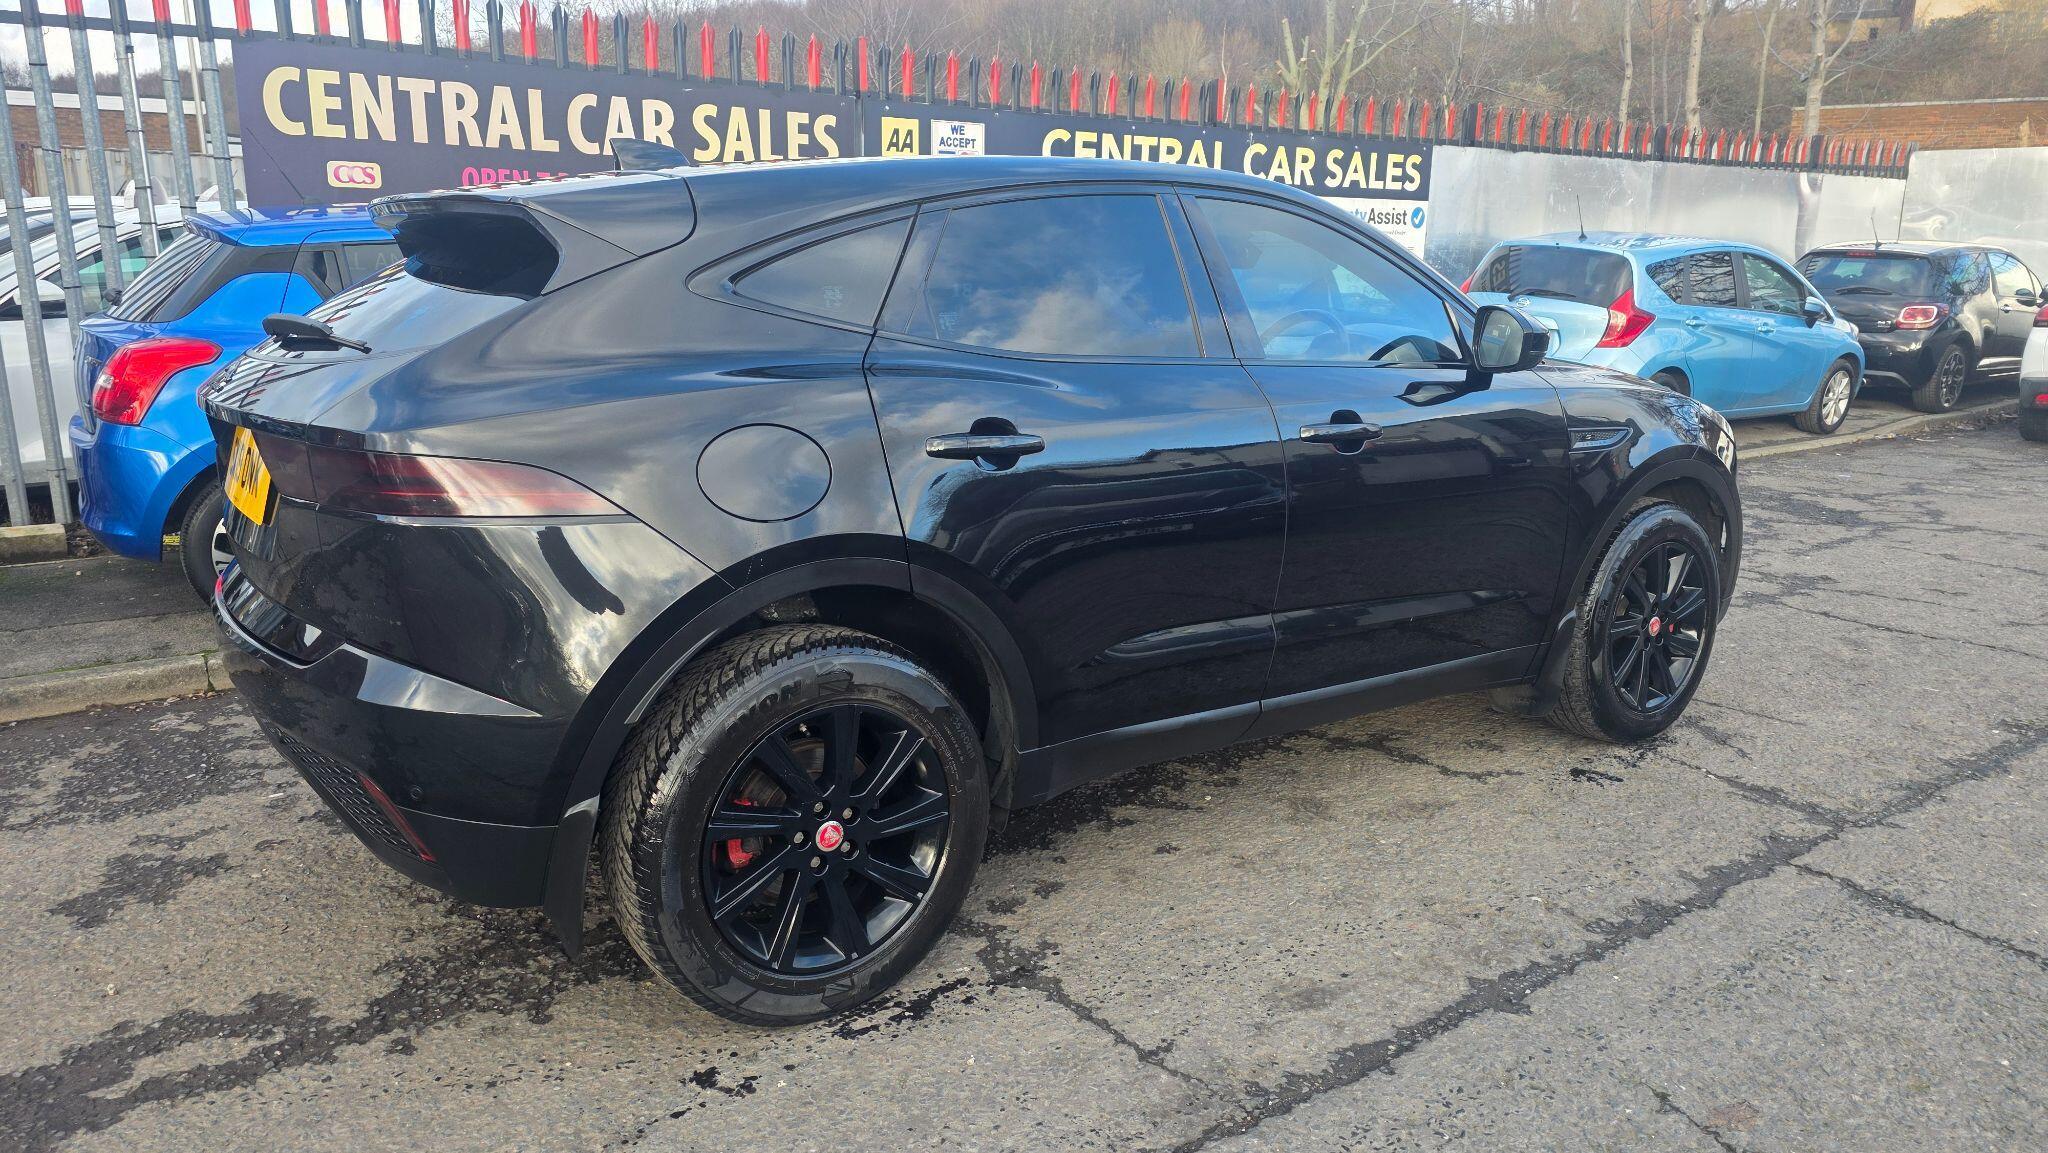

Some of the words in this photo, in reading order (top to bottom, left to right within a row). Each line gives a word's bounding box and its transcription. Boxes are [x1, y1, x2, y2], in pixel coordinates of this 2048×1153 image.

[262, 66, 560, 152] CENTRAL
[567, 93, 675, 155] CAR
[692, 103, 840, 163] SALES
[886, 127, 914, 153] AA
[950, 124, 965, 136] WE
[938, 136, 977, 149] ACCEPT
[1042, 129, 1222, 170] CENTRAL
[1243, 143, 1317, 186] CAR
[1325, 148, 1422, 192] SALES
[333, 164, 376, 185] CCS
